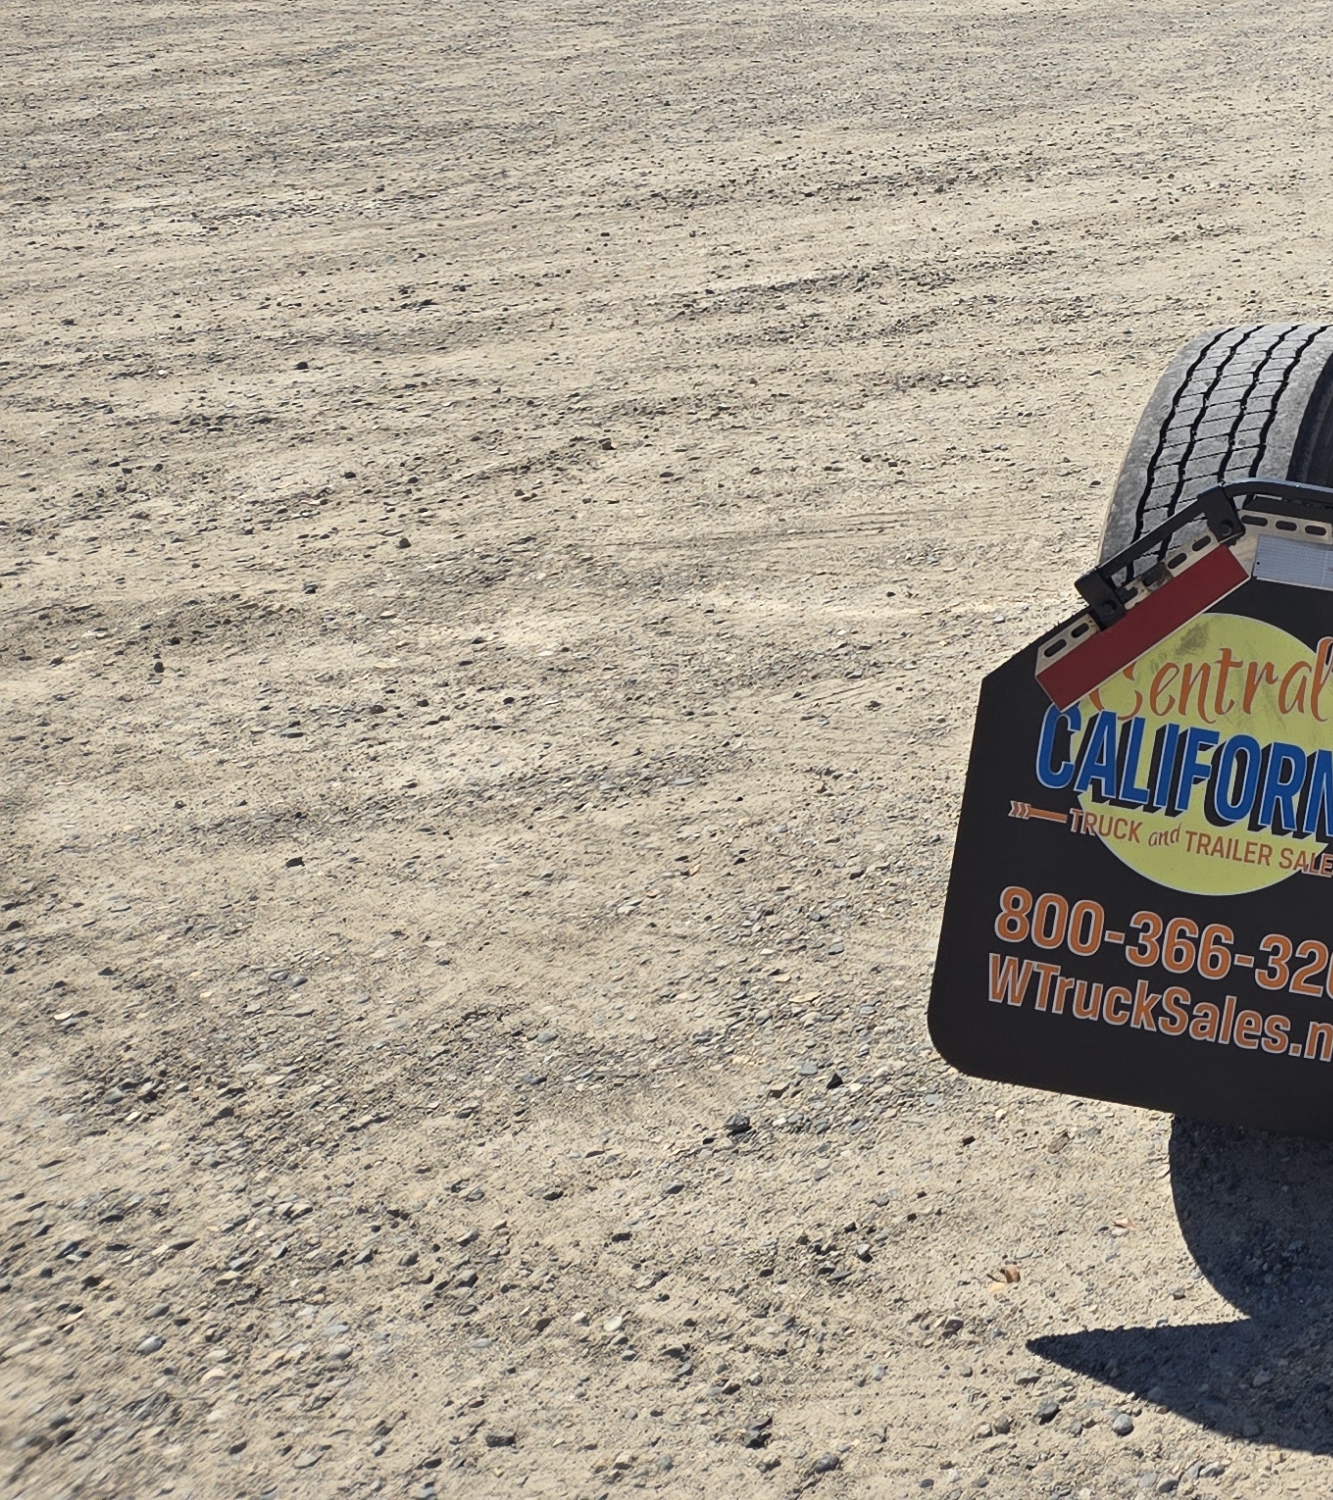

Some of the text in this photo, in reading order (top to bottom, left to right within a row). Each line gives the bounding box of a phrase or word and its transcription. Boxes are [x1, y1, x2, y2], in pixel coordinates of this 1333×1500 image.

[1069, 807, 1143, 844] TRUCK
[1148, 823, 1181, 848] and
[1185, 830, 1274, 867] TRAILER
